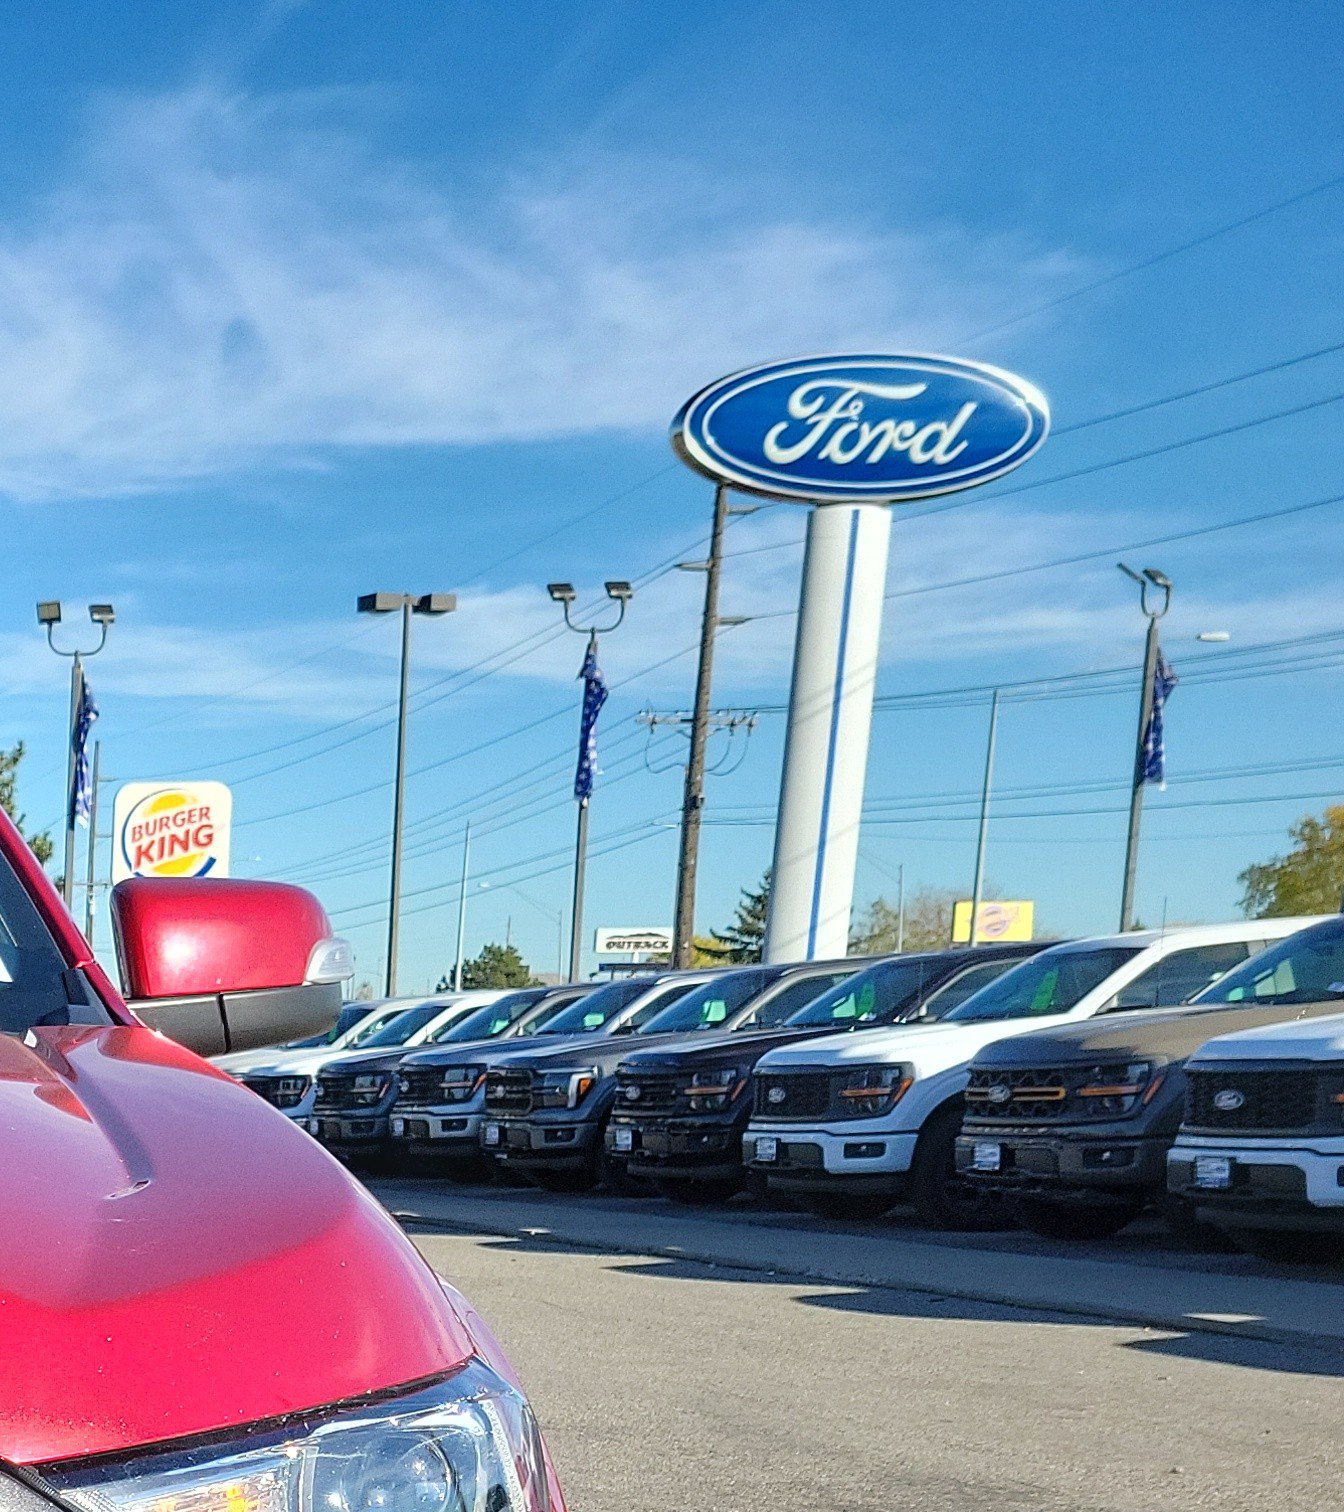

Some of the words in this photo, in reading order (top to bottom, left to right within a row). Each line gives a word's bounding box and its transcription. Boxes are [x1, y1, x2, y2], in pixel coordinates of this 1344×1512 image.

[764, 378, 978, 465] Ford
[132, 806, 211, 843] BURGER
[135, 825, 214, 870] KING
